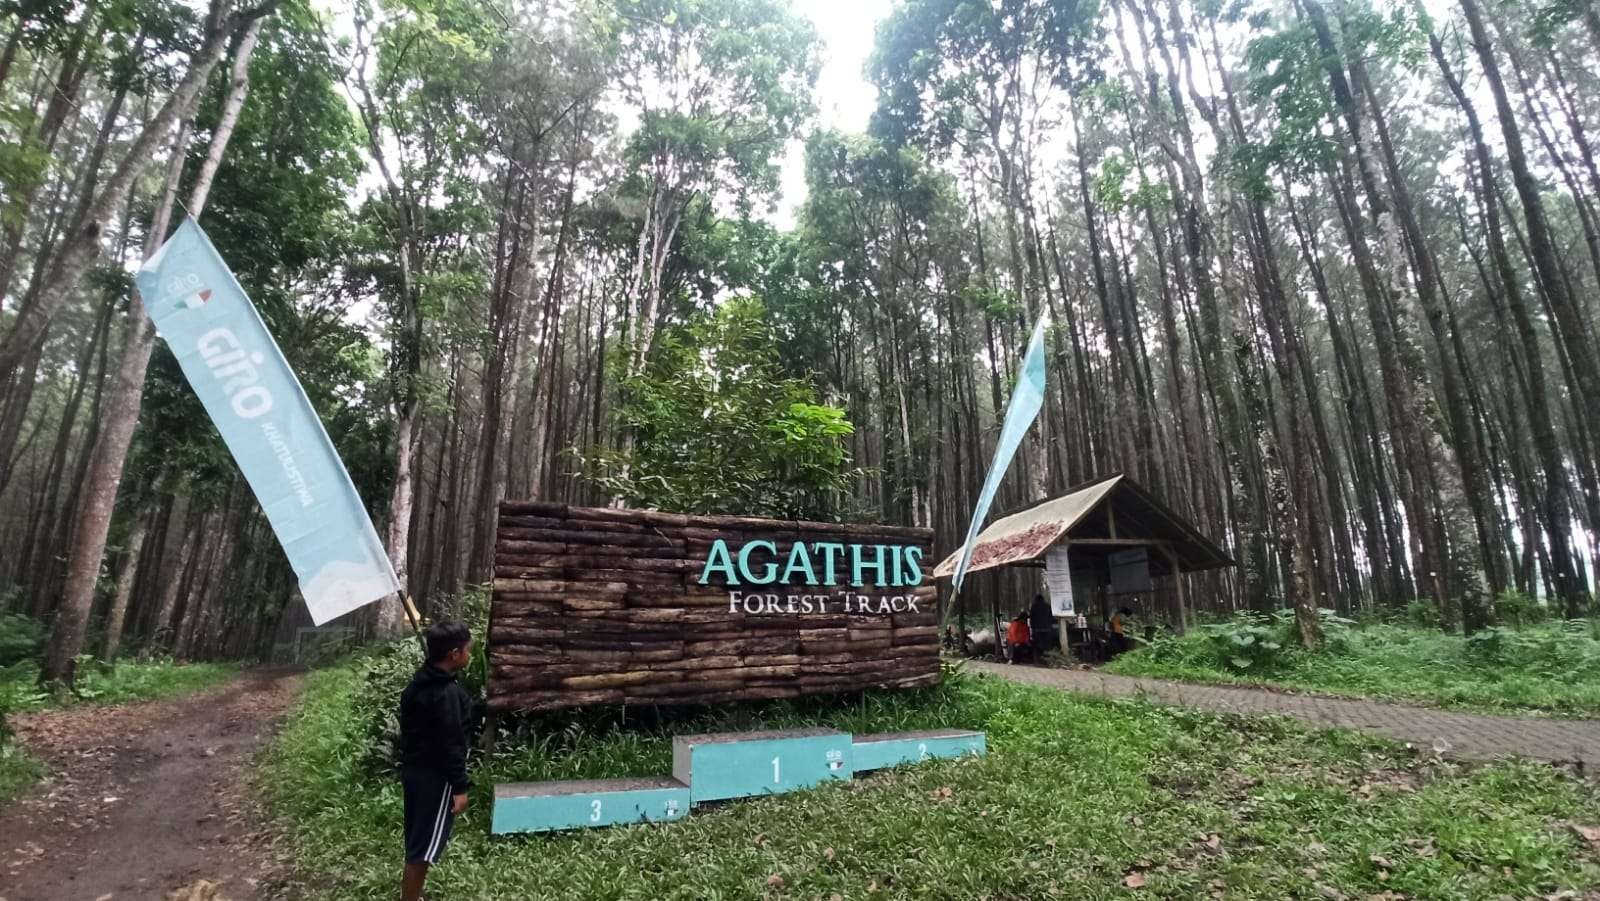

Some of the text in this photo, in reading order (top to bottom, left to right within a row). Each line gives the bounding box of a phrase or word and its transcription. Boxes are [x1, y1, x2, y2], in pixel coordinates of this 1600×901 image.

[697, 538, 923, 587] AGATHIS
[918, 743, 927, 758] 2
[771, 756, 781, 784] 1
[590, 799, 602, 822] 3
